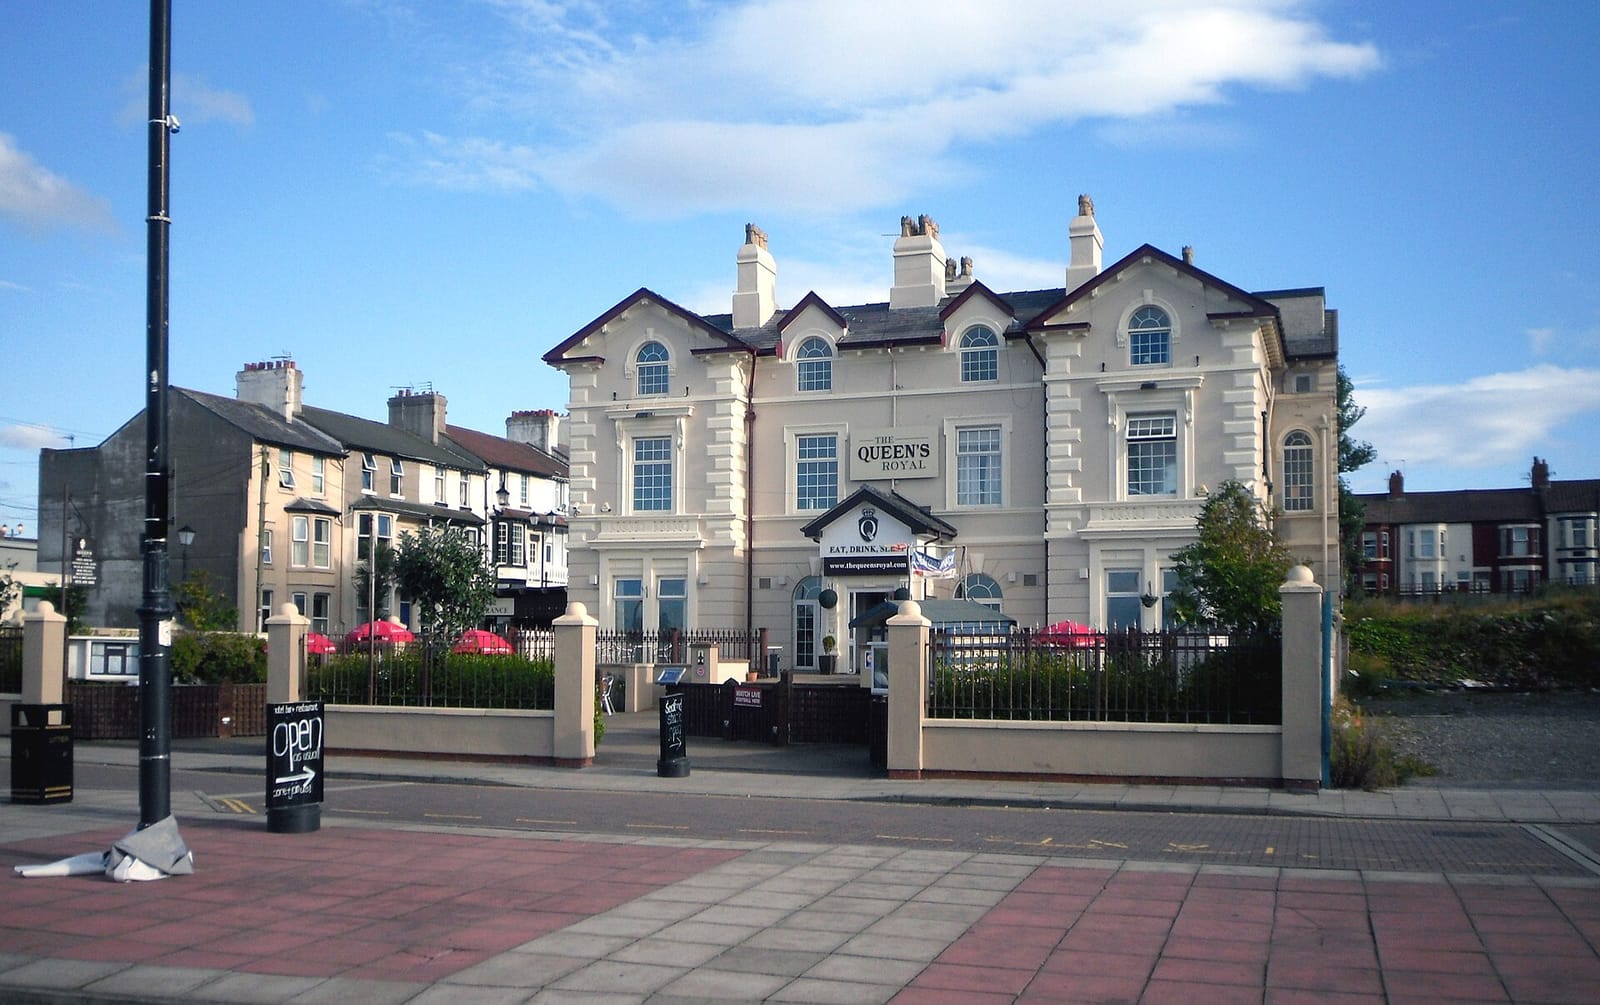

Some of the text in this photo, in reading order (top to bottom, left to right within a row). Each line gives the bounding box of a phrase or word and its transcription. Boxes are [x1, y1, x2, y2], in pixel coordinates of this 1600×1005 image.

[875, 436, 894, 444] THE
[858, 443, 930, 463] QUEEN'S
[882, 460, 926, 471] ROYAL
[829, 545, 848, 555] EAT,
[849, 545, 879, 554] DRINK,
[829, 561, 907, 571] www.thequeensroyal.com
